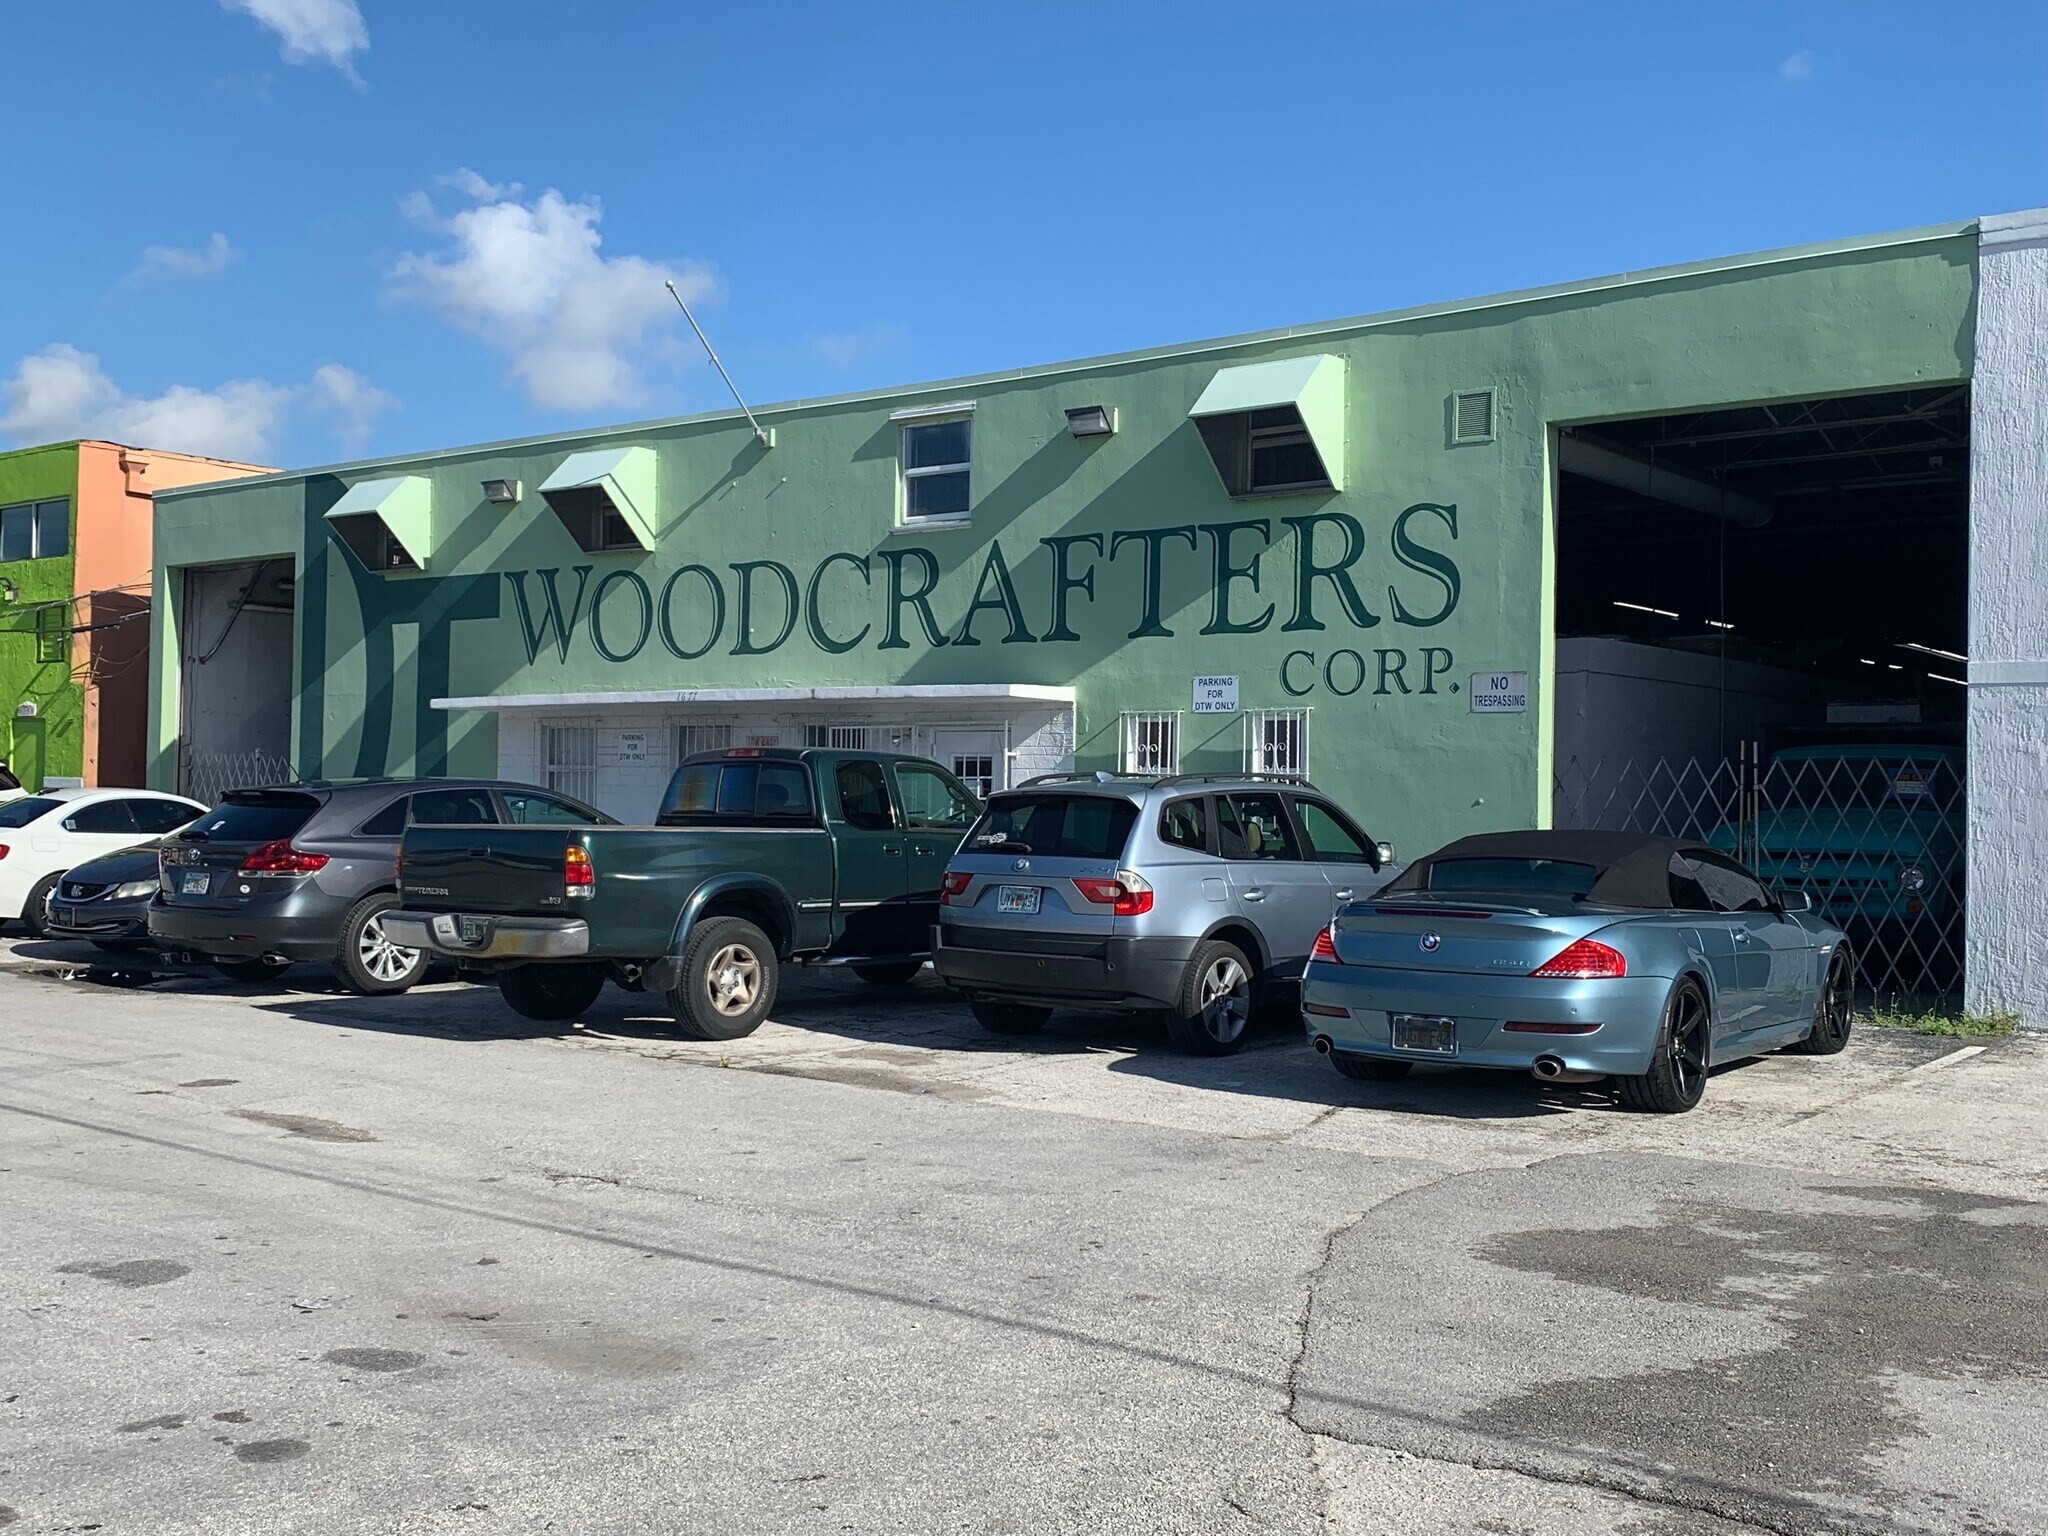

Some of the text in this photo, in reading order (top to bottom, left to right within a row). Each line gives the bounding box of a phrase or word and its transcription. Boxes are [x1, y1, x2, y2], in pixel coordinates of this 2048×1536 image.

[503, 503, 1461, 664] WOODCRAFTERS
[1280, 647, 1460, 696] CORP.
[1198, 677, 1233, 686] PARKING
[1491, 675, 1508, 690] NO
[677, 691, 698, 702] 1677
[1207, 690, 1223, 698] FOR
[1195, 701, 1235, 711] DTW ONLY
[1474, 694, 1525, 707] TRESPASSING
[620, 753, 631, 761] DTW
[417, 886, 448, 897] TUNDRA
